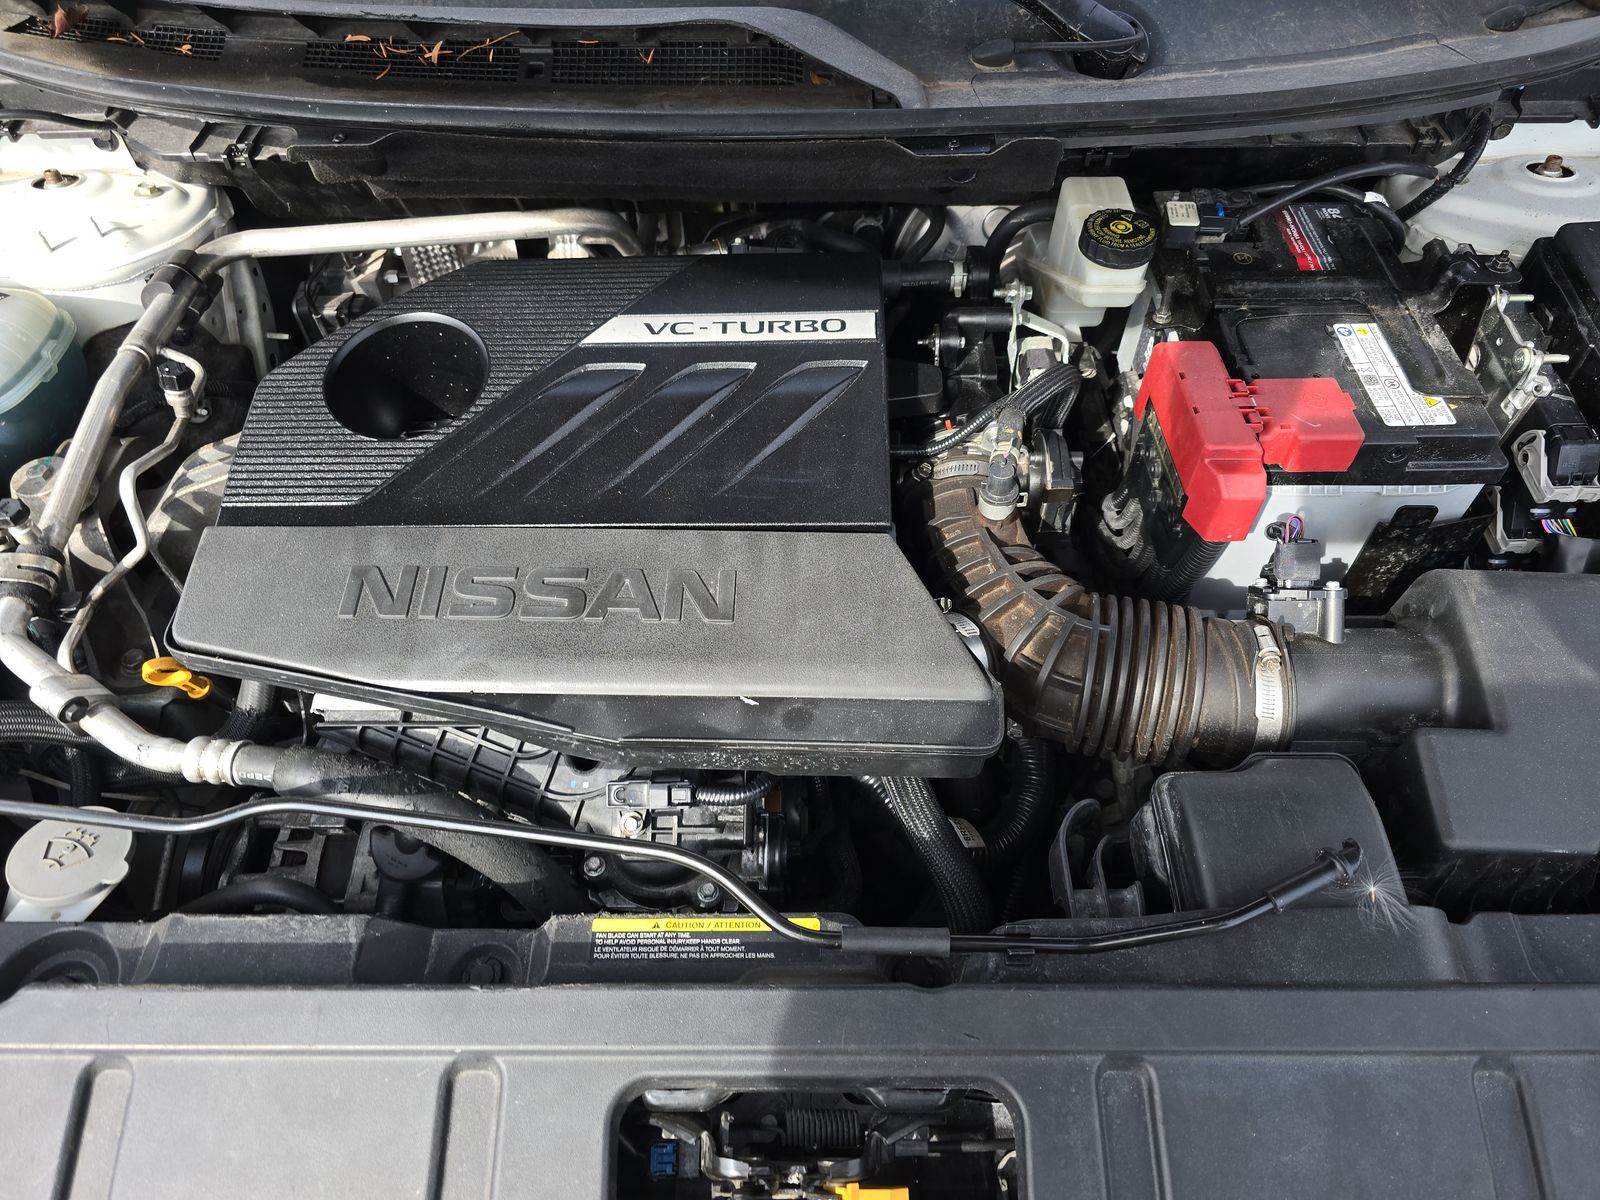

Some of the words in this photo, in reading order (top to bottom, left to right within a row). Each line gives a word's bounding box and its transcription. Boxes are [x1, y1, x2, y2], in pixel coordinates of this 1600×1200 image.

[643, 317, 847, 336] VC-TURBO
[337, 564, 739, 624] NISSAN
[665, 921, 705, 929] CAUTION
[713, 921, 761, 929] ATTENTION
